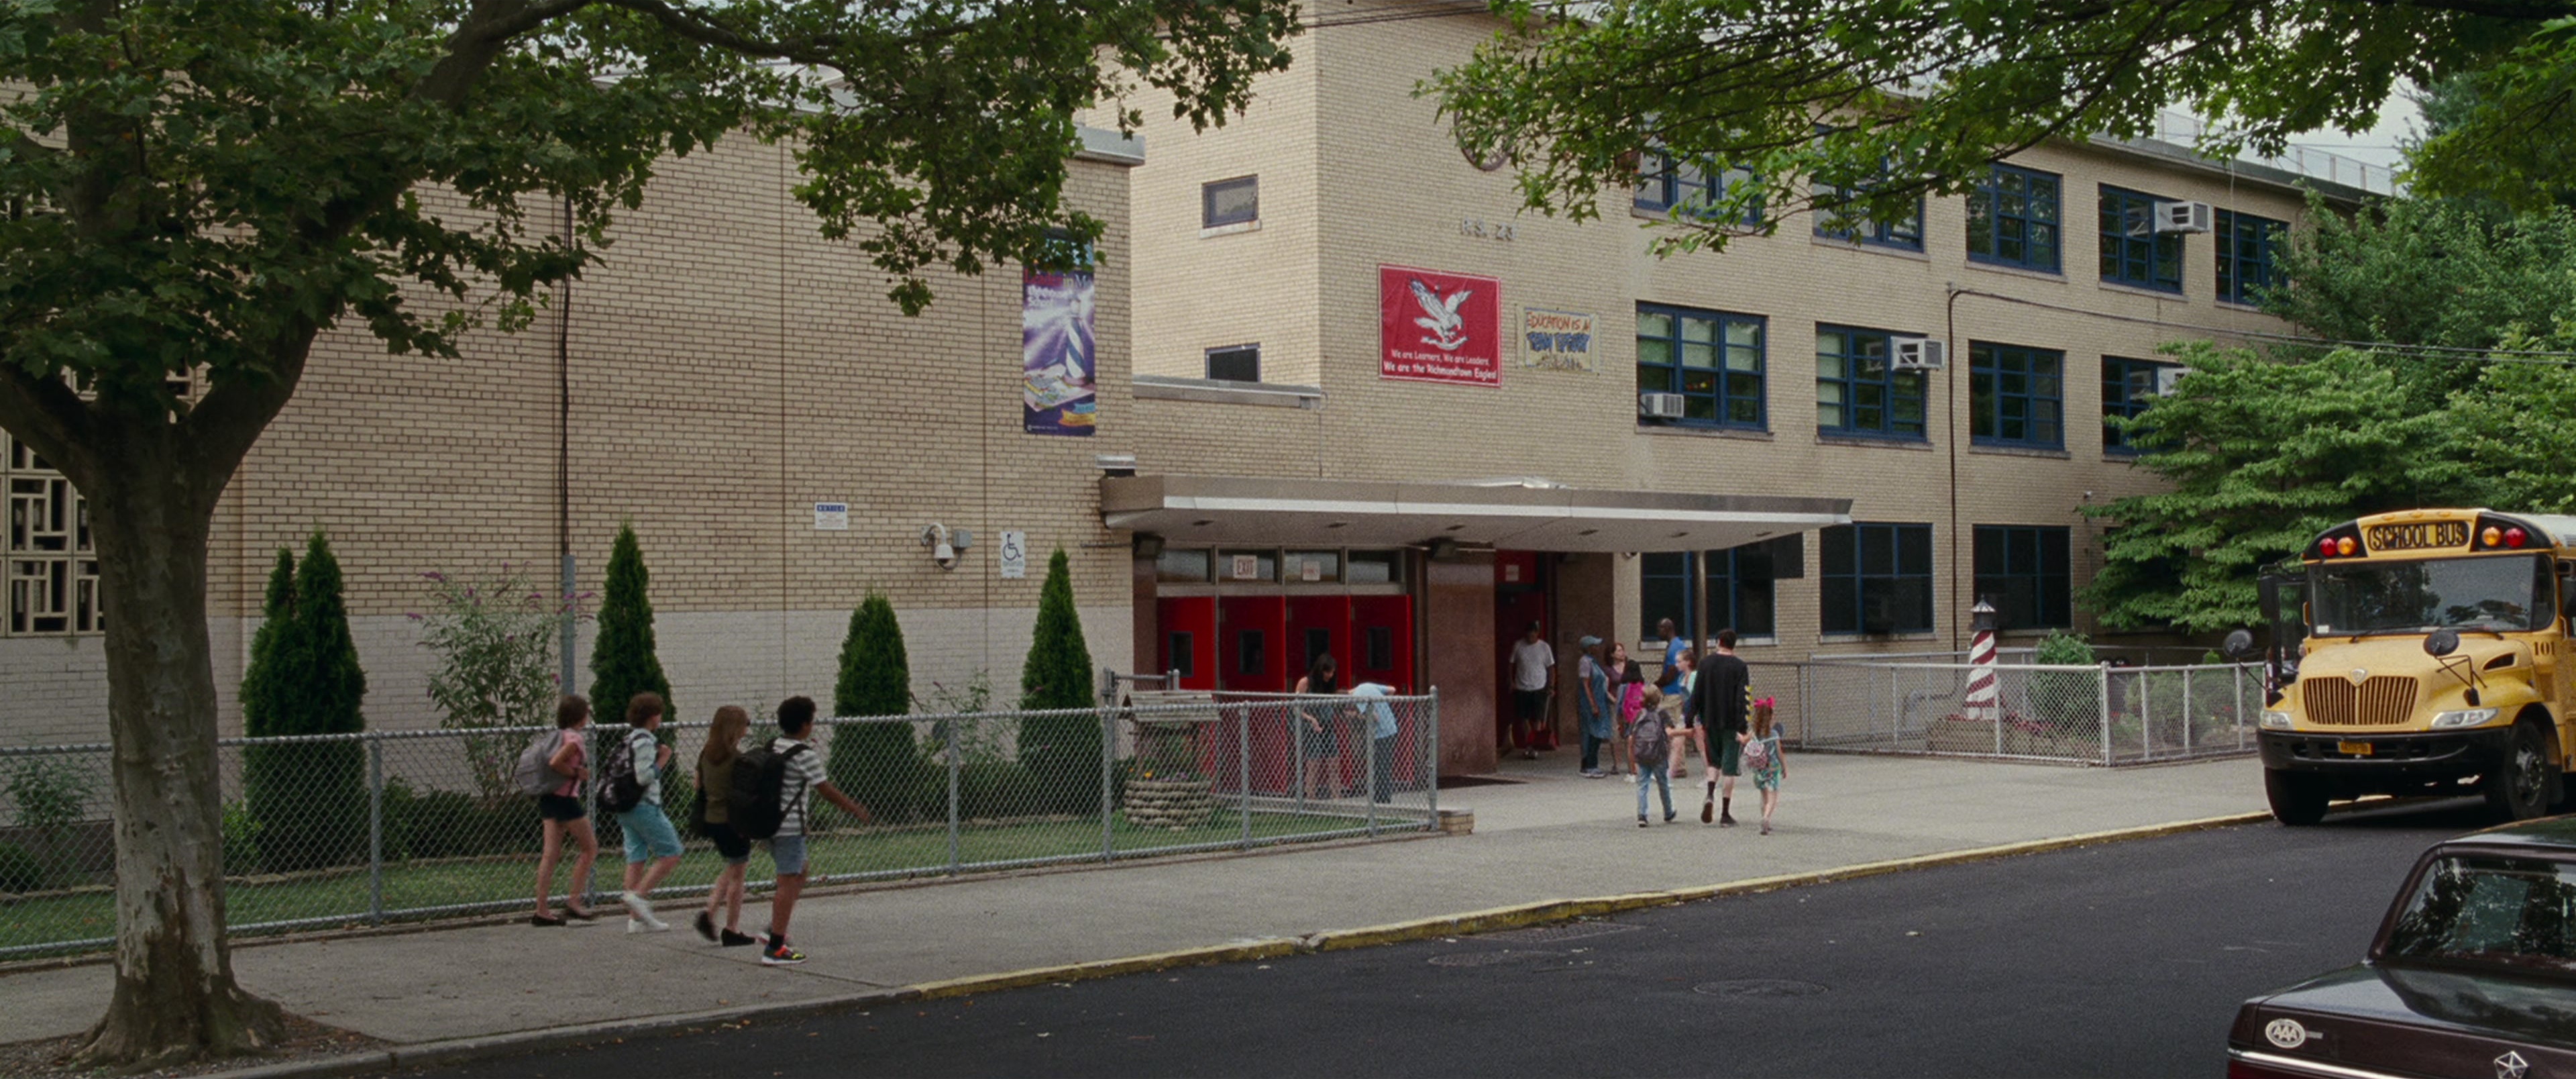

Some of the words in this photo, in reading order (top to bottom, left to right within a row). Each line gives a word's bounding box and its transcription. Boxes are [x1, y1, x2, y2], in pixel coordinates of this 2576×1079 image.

[1391, 348, 1401, 358] We
[1442, 353, 1454, 362] We
[1383, 360, 1395, 371] We
[1397, 364, 1410, 372] are
[1412, 363, 1426, 373] the
[2373, 523, 2434, 550] SCHOOL
[2436, 521, 2466, 546] BUS
[1237, 559, 1254, 575] EXIT
[2534, 641, 2555, 656] 101
[2272, 1025, 2299, 1042] AAA
